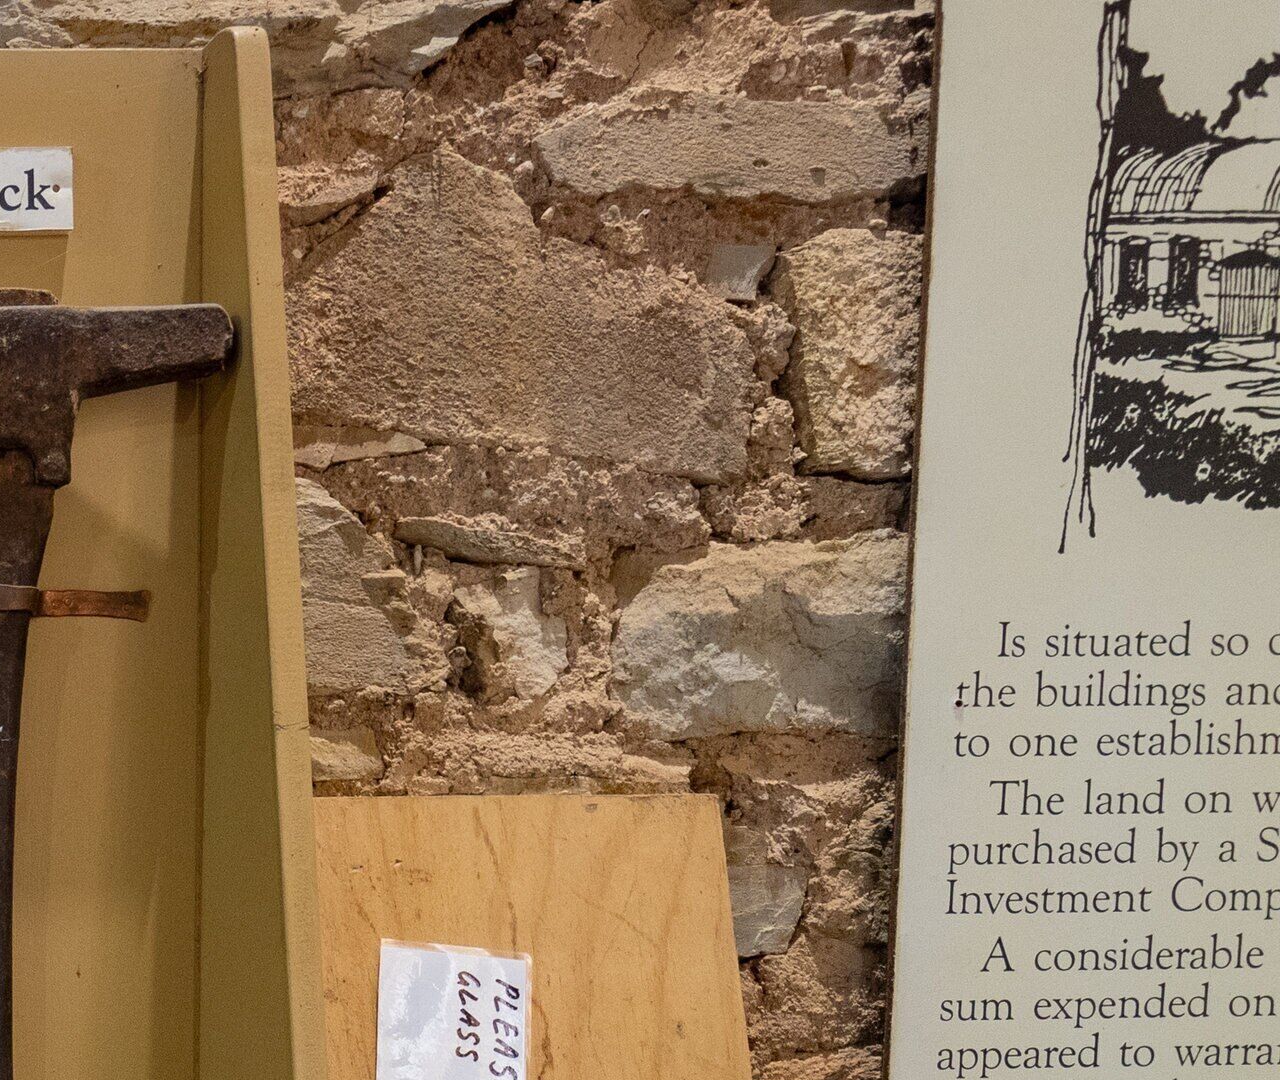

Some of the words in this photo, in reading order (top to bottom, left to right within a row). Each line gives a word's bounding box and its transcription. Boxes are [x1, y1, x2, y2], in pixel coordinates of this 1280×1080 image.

[998, 621, 1026, 658] Is
[1045, 619, 1191, 658] situated
[1210, 633, 1249, 657] so
[955, 670, 1016, 708] the
[1036, 669, 1206, 716] buildings
[954, 731, 990, 758] to
[1009, 734, 1078, 757] one
[989, 778, 1065, 816] The
[1083, 777, 1165, 815] land
[1184, 791, 1232, 814] on
[947, 827, 1137, 875] purchased
[1156, 826, 1200, 872] by
[1218, 840, 1237, 863] a
[945, 879, 1152, 915] Investment
[980, 936, 1015, 973] A
[1034, 932, 1264, 972] considerable
[454, 970, 481, 1062] GLASS
[939, 998, 1014, 1022] sum
[1033, 981, 1209, 1028] expended
[1227, 995, 1276, 1018] on
[936, 1032, 1100, 1079] appeared
[1119, 1042, 1155, 1067] to
[1174, 1043, 1280, 1067] warra
